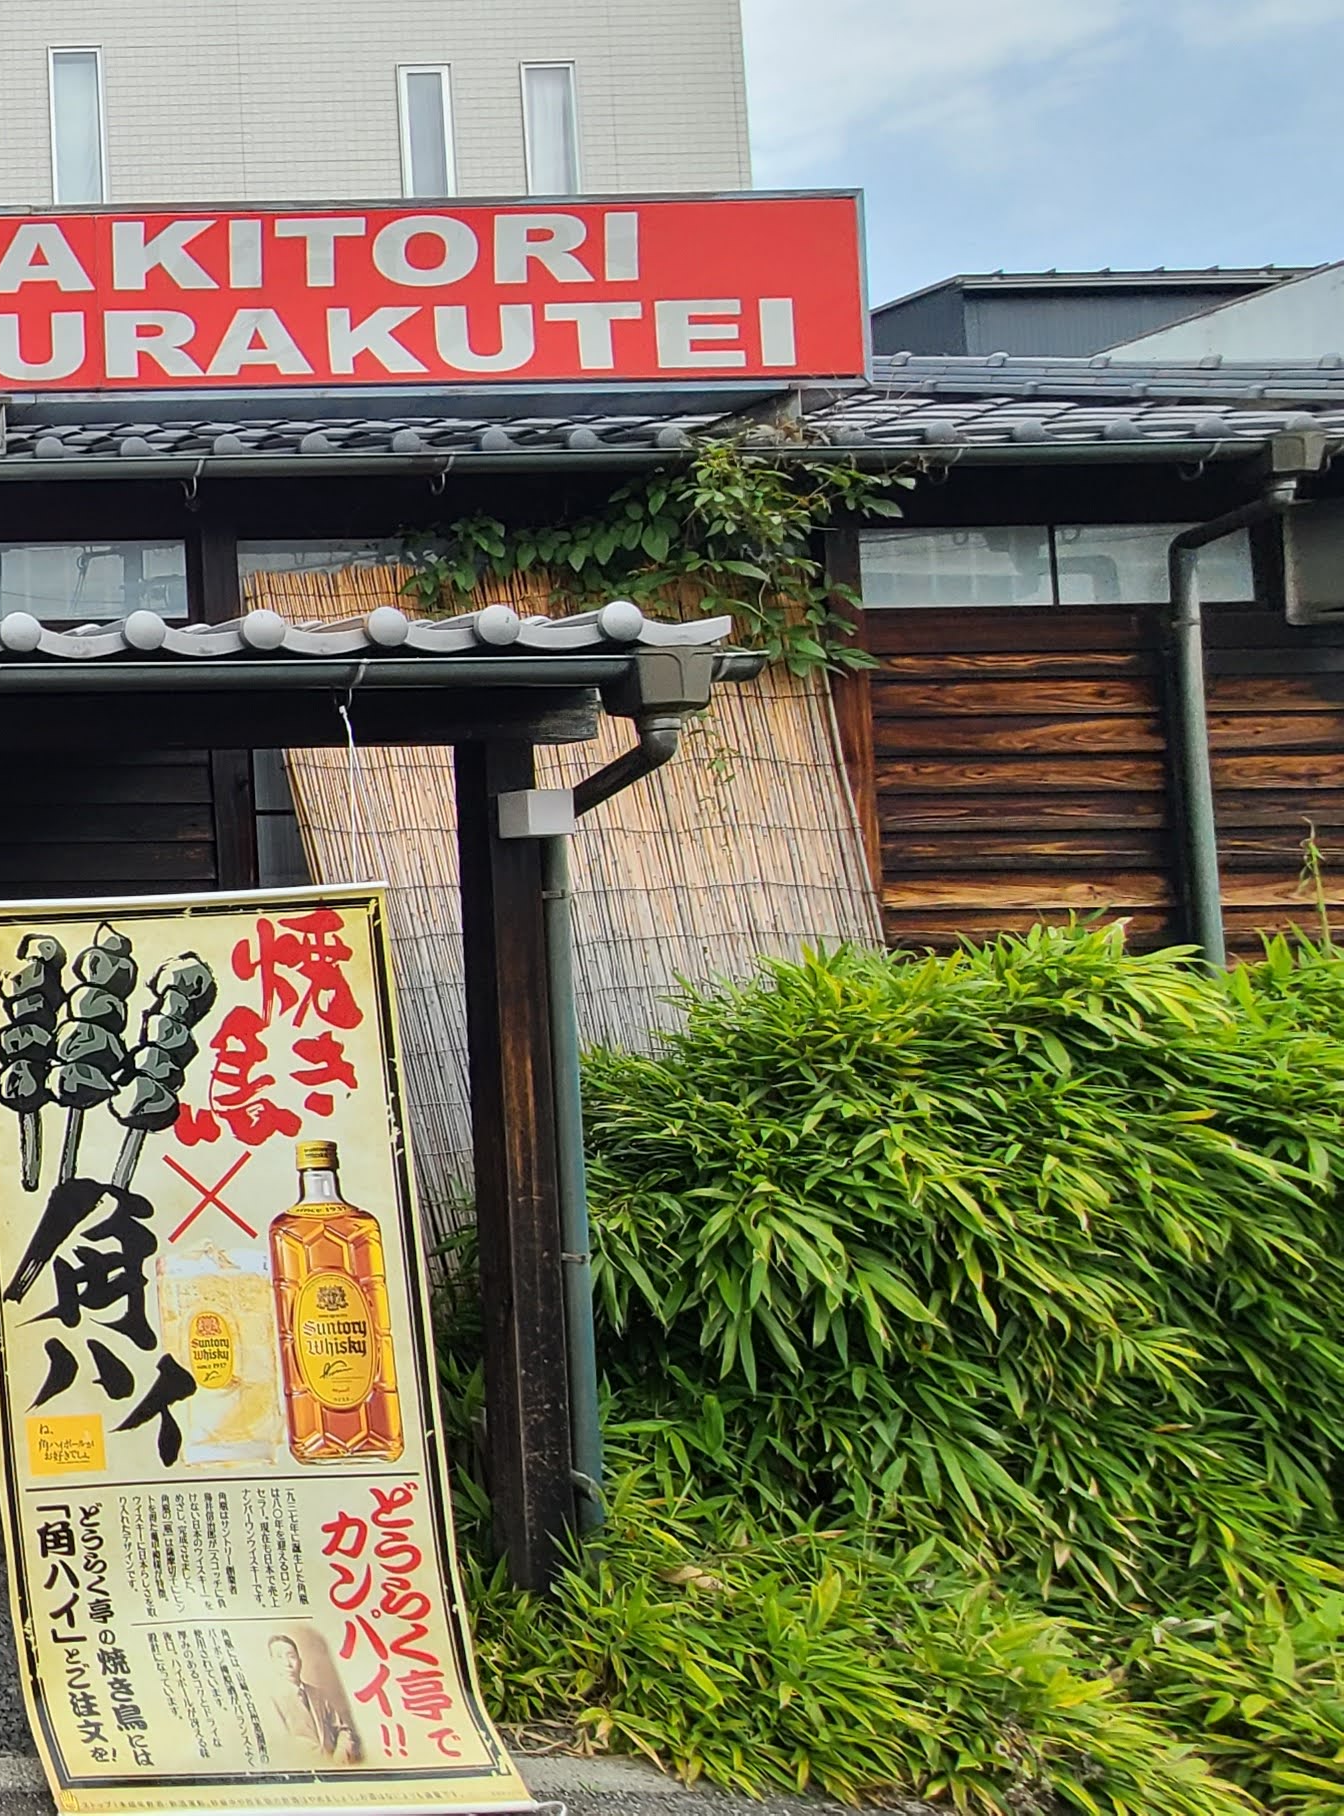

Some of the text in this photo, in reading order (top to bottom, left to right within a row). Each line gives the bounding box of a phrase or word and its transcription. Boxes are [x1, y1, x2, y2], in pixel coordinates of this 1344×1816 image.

[4, 1178, 197, 1468] 角ハイ
[303, 1319, 368, 1338] Suntory
[191, 1338, 230, 1350] Suntory
[307, 1338, 367, 1357] Whisky
[193, 1349, 230, 1362] Whisky
[369, 1481, 462, 1759] どうらく亭で
[78, 1501, 155, 1767] どうらく亭の焼き鳥には
